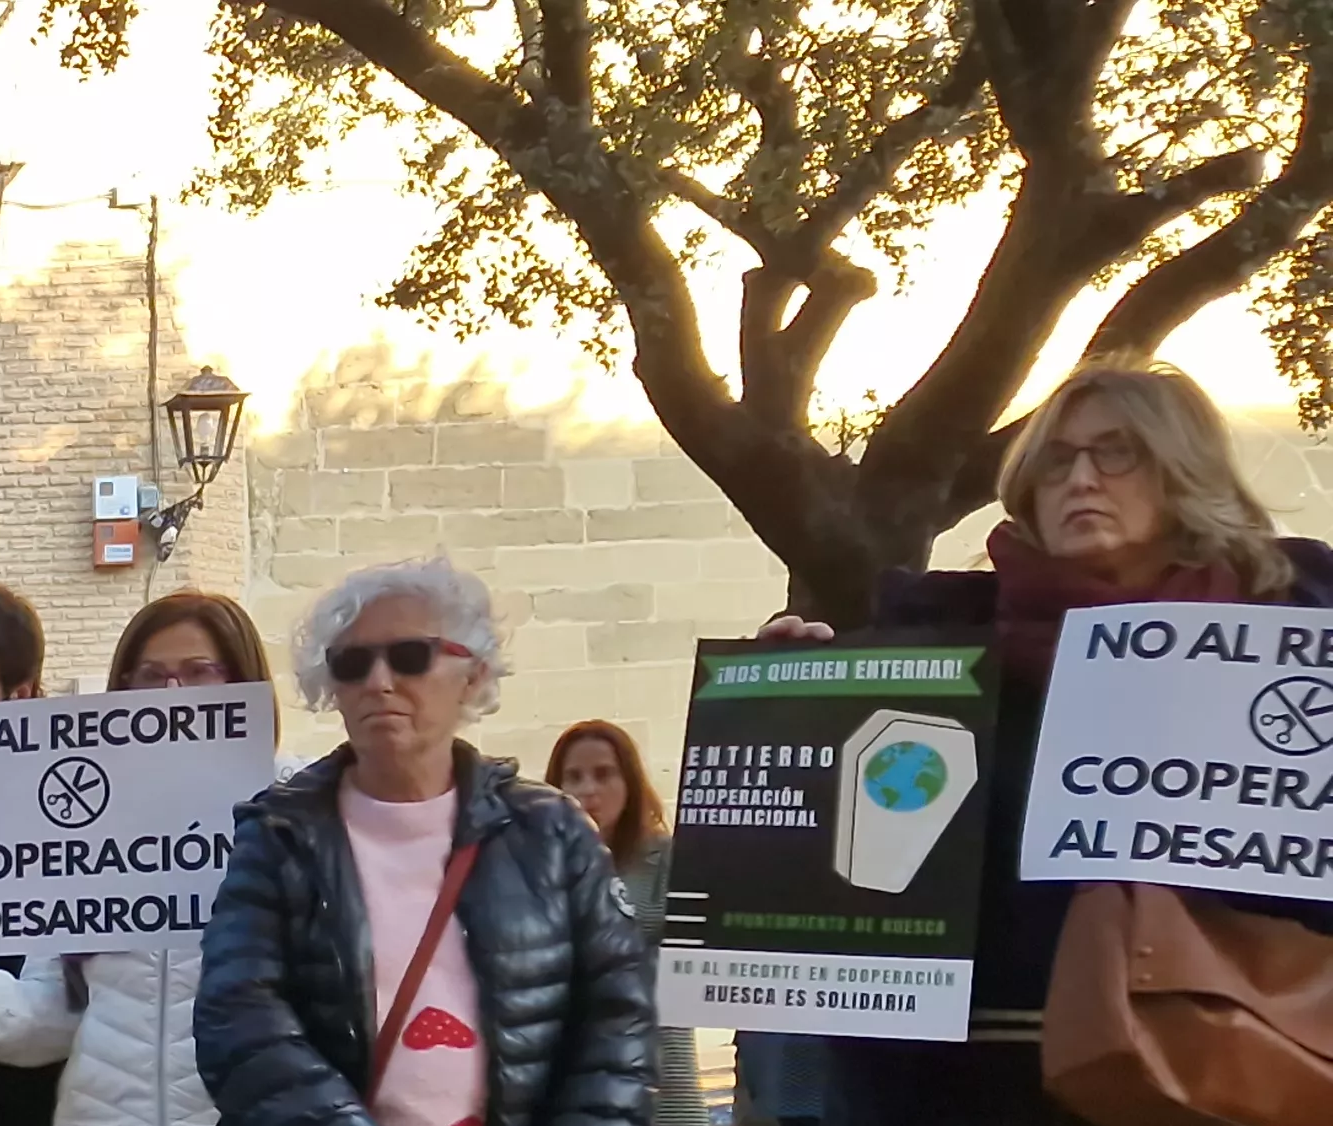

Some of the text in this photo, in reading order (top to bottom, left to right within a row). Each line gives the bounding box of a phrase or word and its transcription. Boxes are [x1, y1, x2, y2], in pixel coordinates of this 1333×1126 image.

[1086, 620, 1178, 660] NO
[1184, 622, 1260, 664] AL
[767, 660, 848, 683] QUIEREN
[855, 659, 962, 681] ENTERRAR!
[50, 701, 248, 750] RECORTE
[687, 745, 834, 768] ENTIERRO
[684, 770, 768, 787] POR LA
[681, 786, 804, 807] COOPERACIÓN
[679, 808, 818, 828] INTERNACIONAL
[1049, 819, 1118, 859] AL
[672, 959, 956, 987] NO AL RECORTE EN COOPERACIÓN
[704, 984, 917, 1013] HUESCA ES SOLIDARIA
